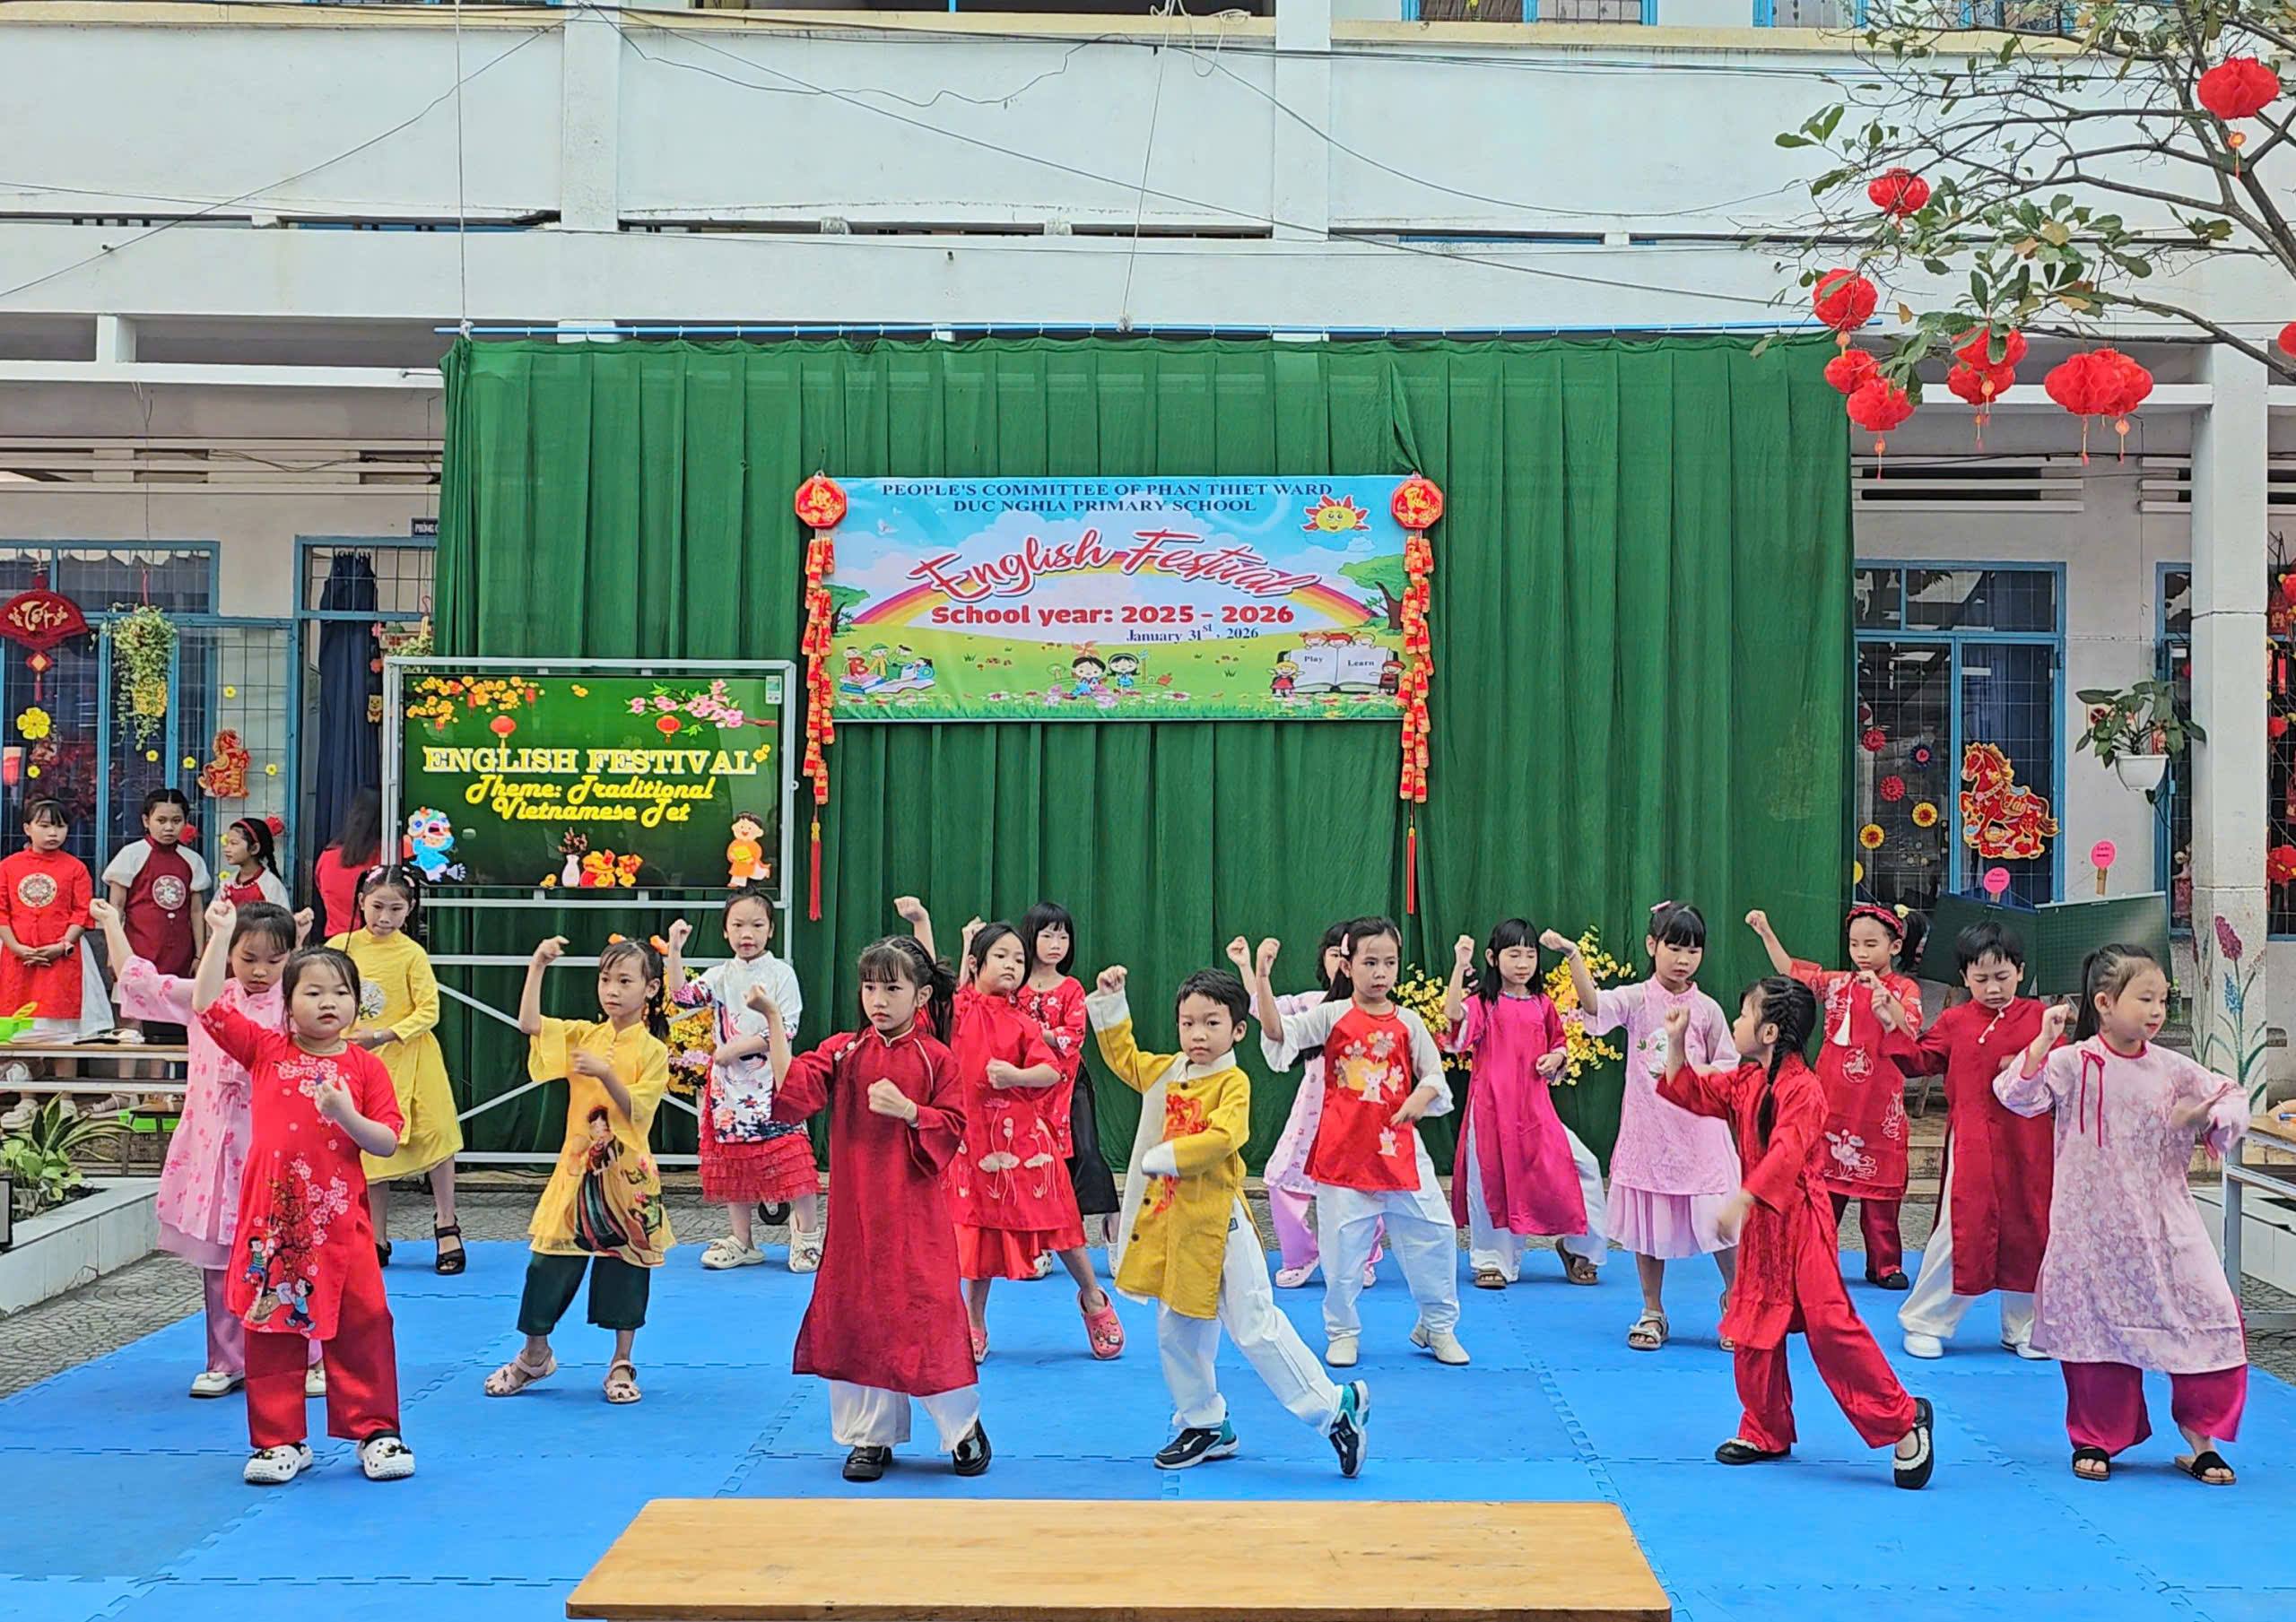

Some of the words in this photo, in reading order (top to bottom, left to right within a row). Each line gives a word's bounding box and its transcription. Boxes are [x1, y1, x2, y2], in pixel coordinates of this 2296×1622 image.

[883, 484, 977, 496] PEOPLE'S
[982, 484, 1109, 496] COMMITTEE
[1114, 484, 1143, 496] OF
[1147, 484, 1205, 496] PHAN
[1207, 484, 1268, 496] THIET
[1274, 483, 1333, 496] WARD
[953, 500, 996, 512] DUC
[1000, 500, 1065, 512] NGHIA
[1072, 500, 1167, 512] PRIMARY
[1172, 500, 1257, 512] SCHOOL
[908, 528, 1113, 600] English
[1123, 528, 1320, 595] Festival
[931, 604, 1031, 624] School
[1038, 608, 1114, 627] year:
[1121, 605, 1195, 623] 2025
[1221, 605, 1294, 623] 2026
[1126, 629, 1183, 644] January
[1226, 628, 1259, 639] 2026
[1304, 655, 1324, 664] Play
[1347, 659, 1375, 667] Learn
[422, 746, 579, 774] ENGLISH
[586, 749, 757, 776] FESTIVAL
[465, 774, 563, 804] Theme:
[566, 775, 717, 805] Traditional
[491, 796, 638, 820] Vietnamese
[640, 797, 691, 828] Tet
